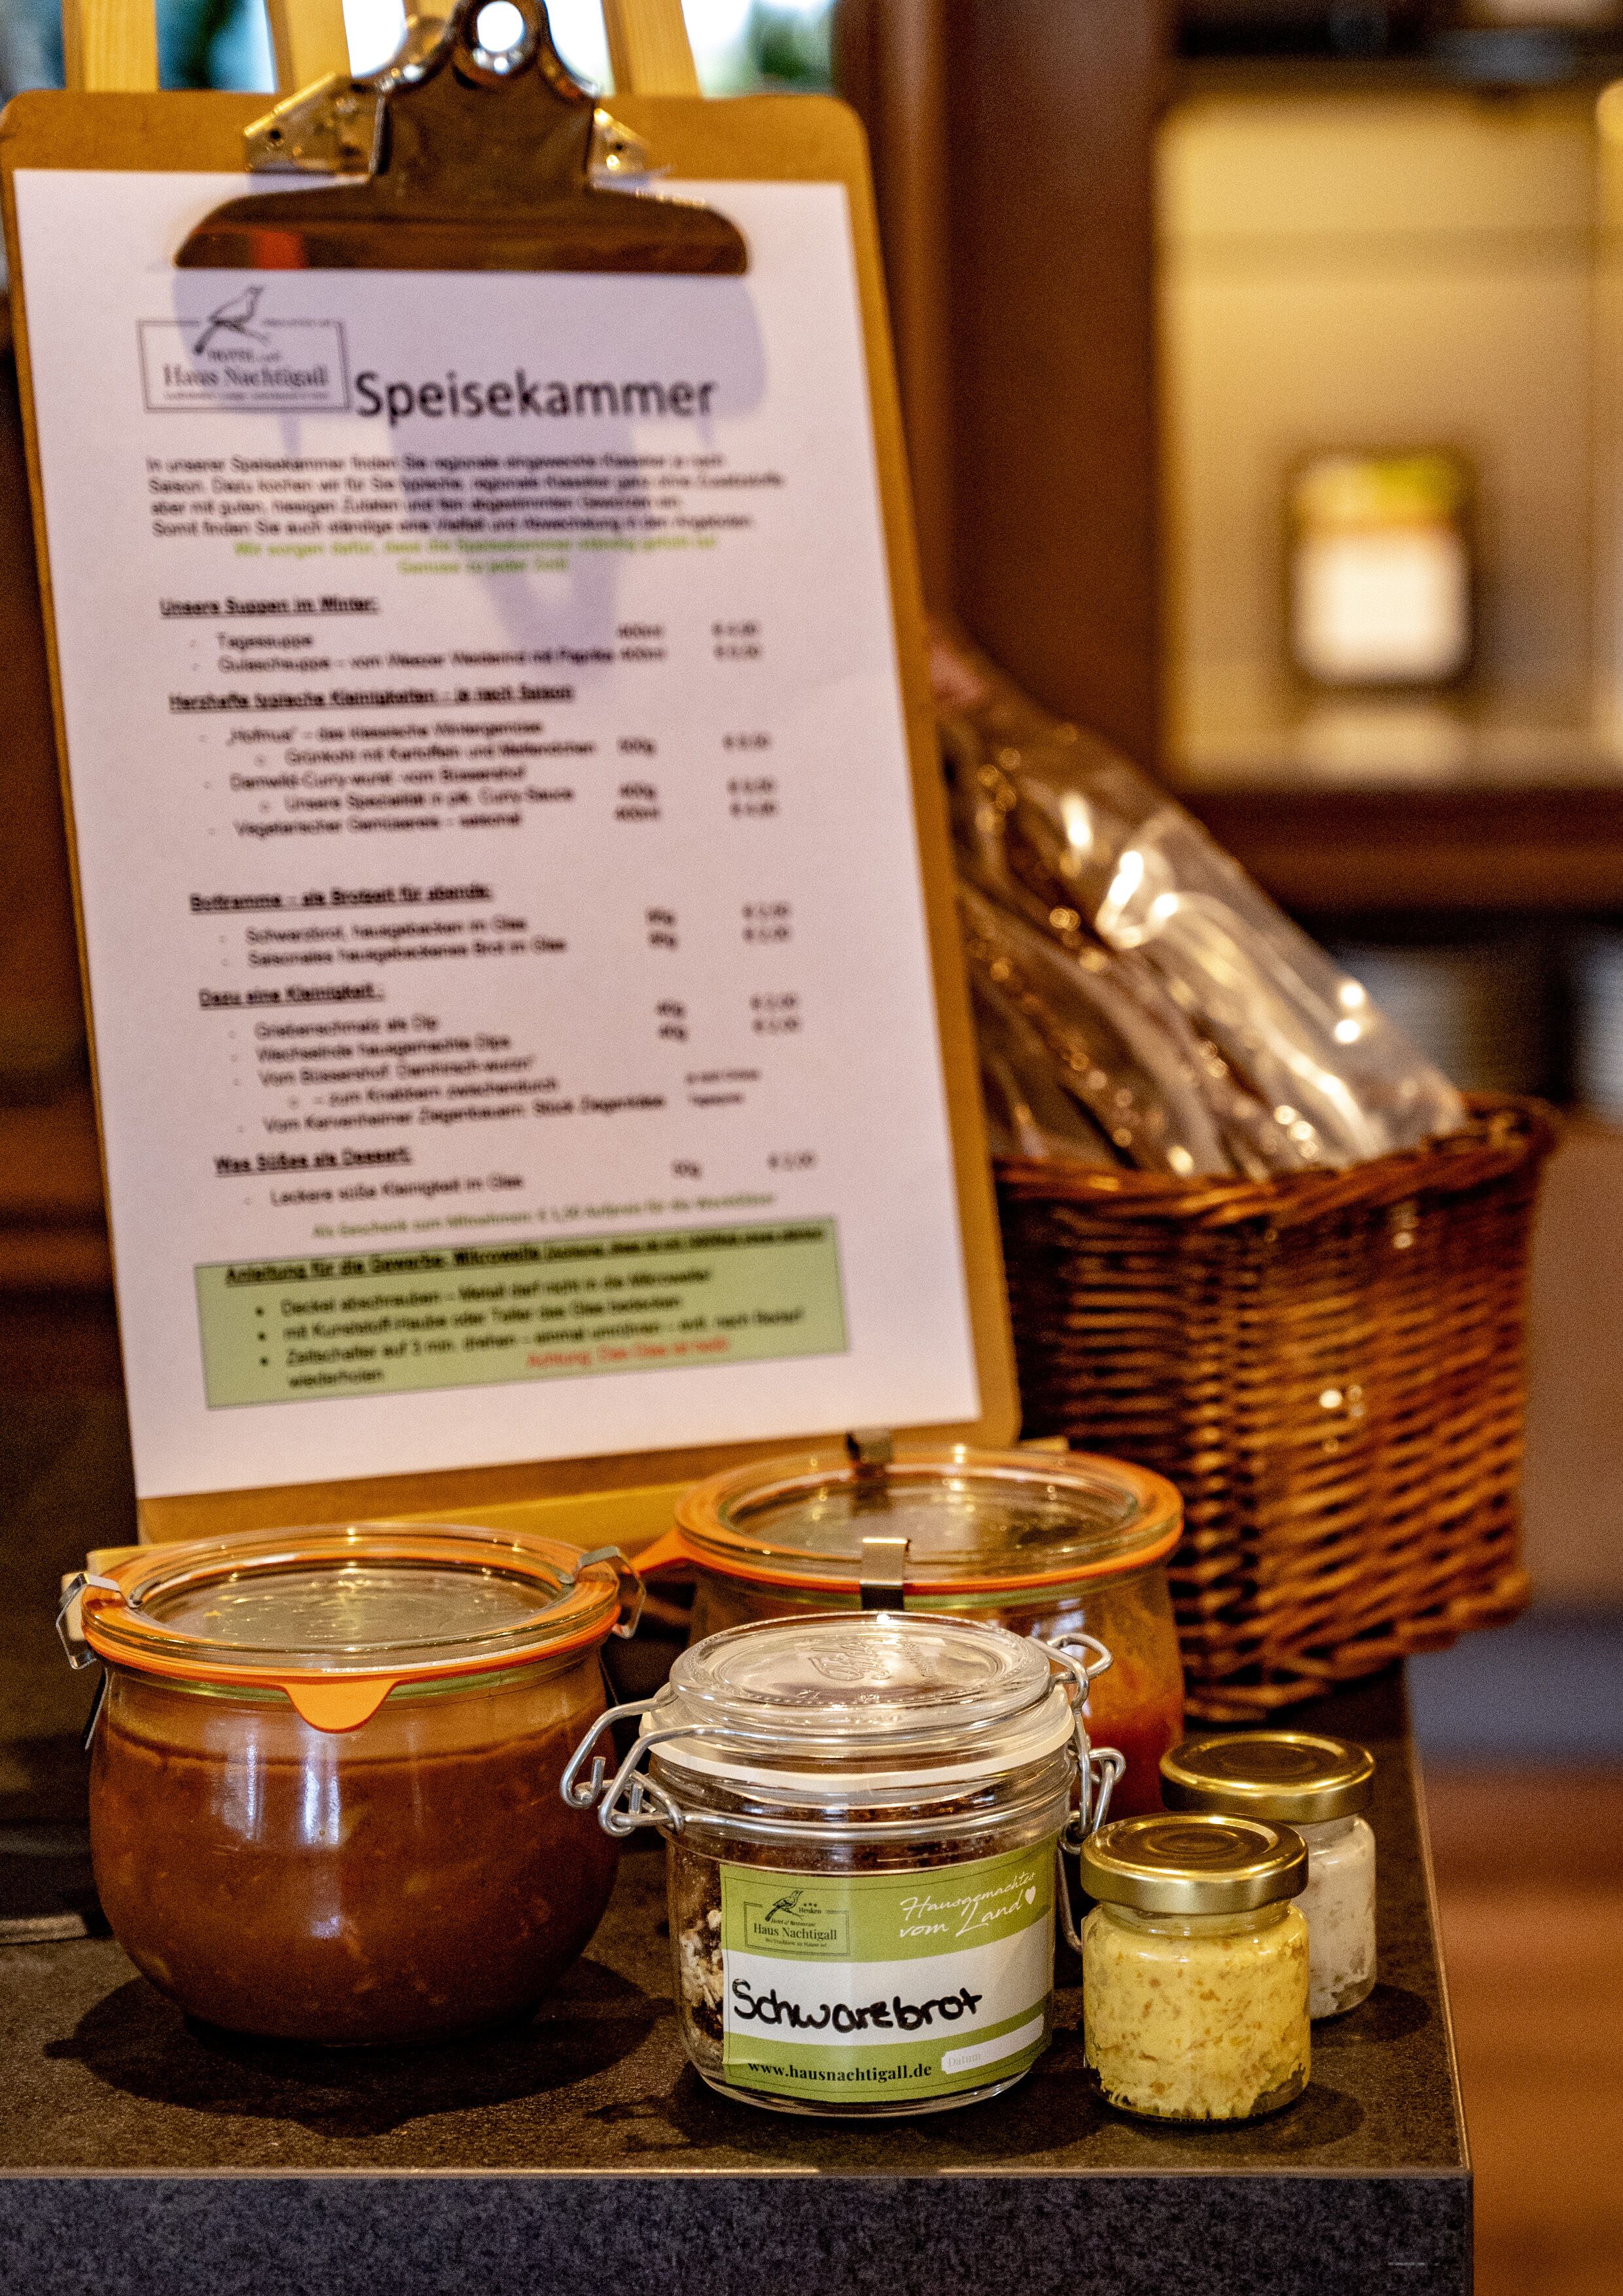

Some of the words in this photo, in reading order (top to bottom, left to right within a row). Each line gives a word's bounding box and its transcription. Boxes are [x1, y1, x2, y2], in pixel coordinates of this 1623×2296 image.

[355, 368, 718, 429] Speisekammer
[899, 1922, 950, 1939] vom
[955, 1888, 1024, 1938] Land
[900, 1871, 1037, 1922] Hausgemachtes
[753, 1923, 779, 1936] Haus
[782, 1927, 838, 1942] Nachtigall
[747, 2062, 933, 2083] www.hausnachtigall.de
